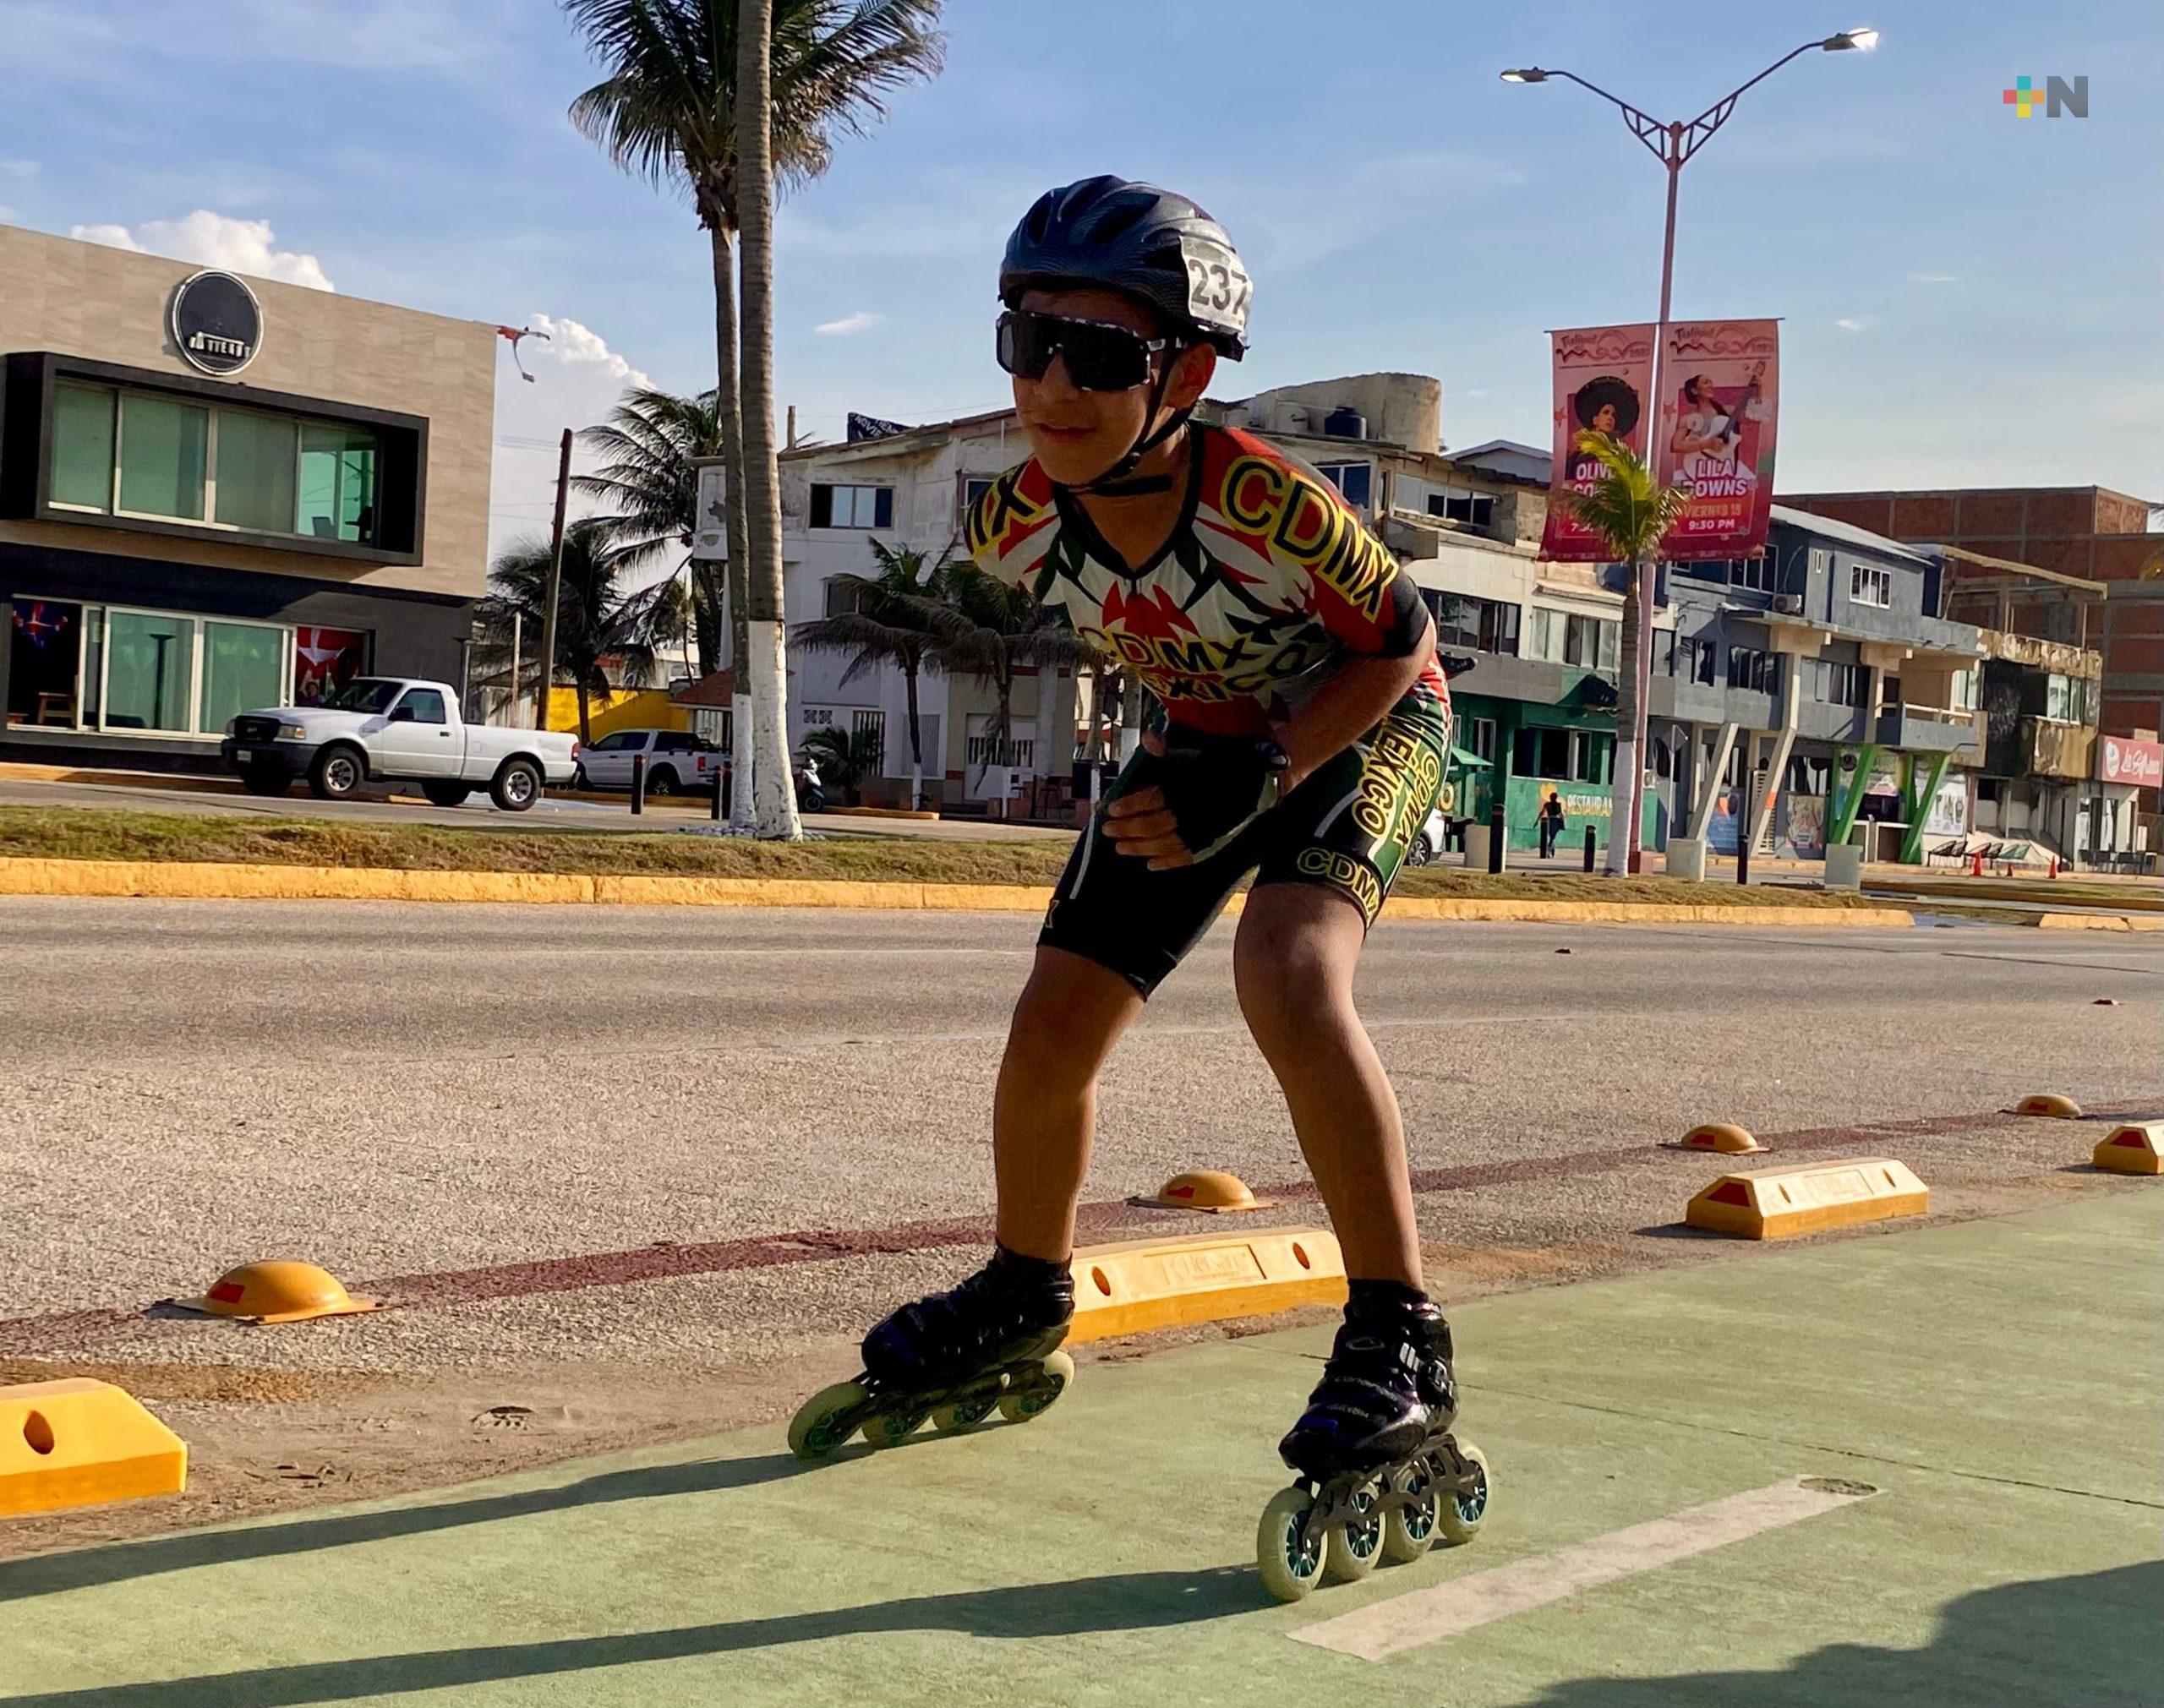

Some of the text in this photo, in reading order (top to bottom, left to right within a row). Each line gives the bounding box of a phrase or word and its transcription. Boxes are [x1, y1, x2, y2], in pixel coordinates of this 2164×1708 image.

[1189, 259, 1247, 314] 237
[1697, 459, 1734, 479] LILA
[1221, 456, 1399, 623] CDMX
[1718, 518, 1735, 529] PM
